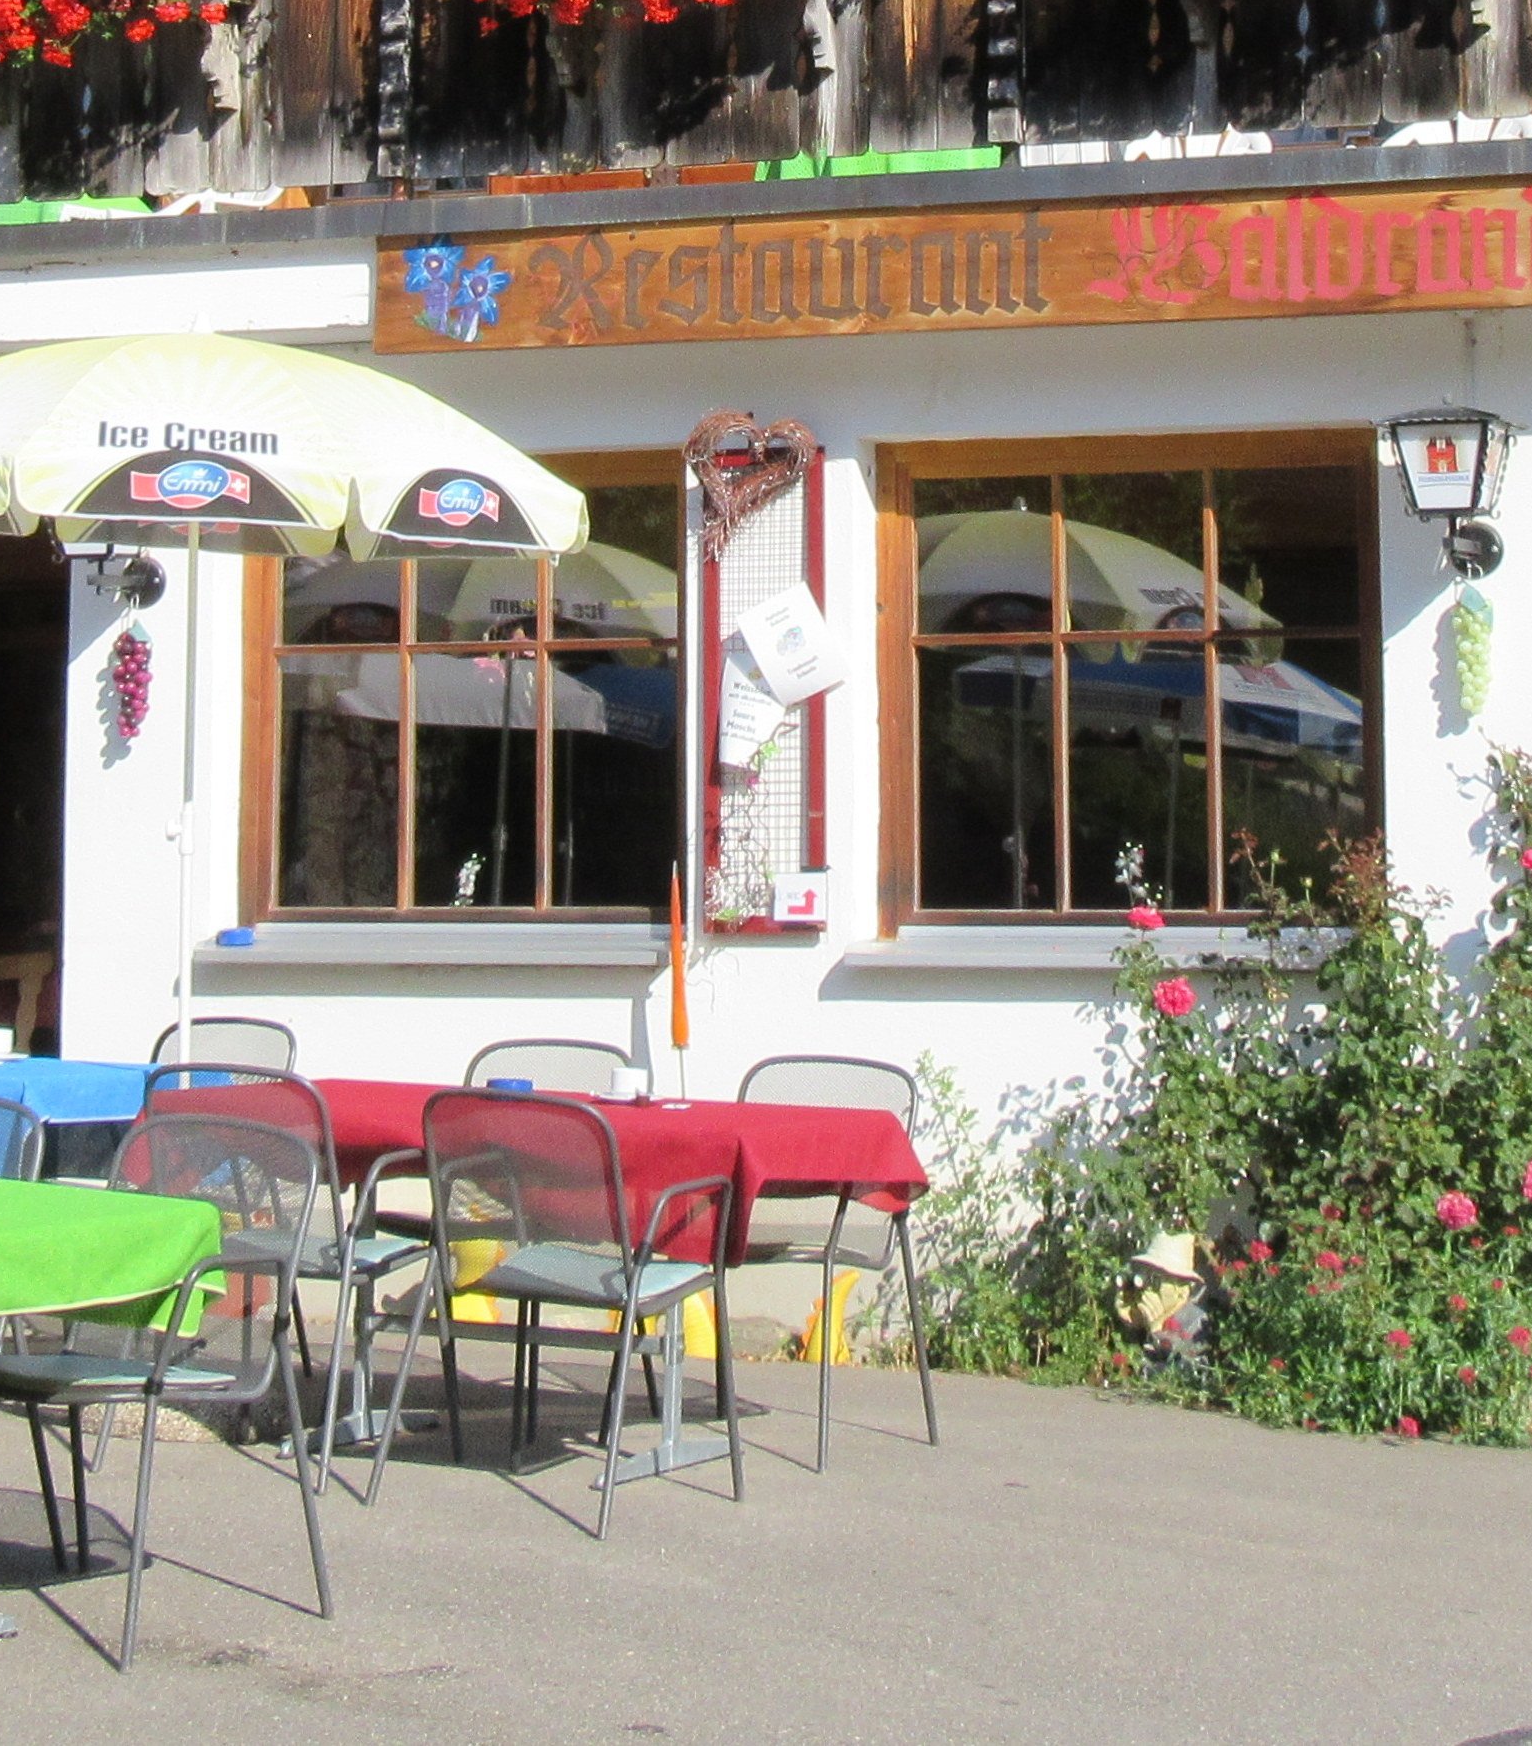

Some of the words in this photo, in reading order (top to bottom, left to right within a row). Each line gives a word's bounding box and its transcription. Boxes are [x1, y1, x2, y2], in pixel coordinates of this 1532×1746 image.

[528, 206, 1053, 331] Restaurant
[97, 420, 149, 448] Ice
[163, 422, 280, 455] Cream
[162, 471, 223, 493] Emmi
[440, 489, 482, 511] Emmi
